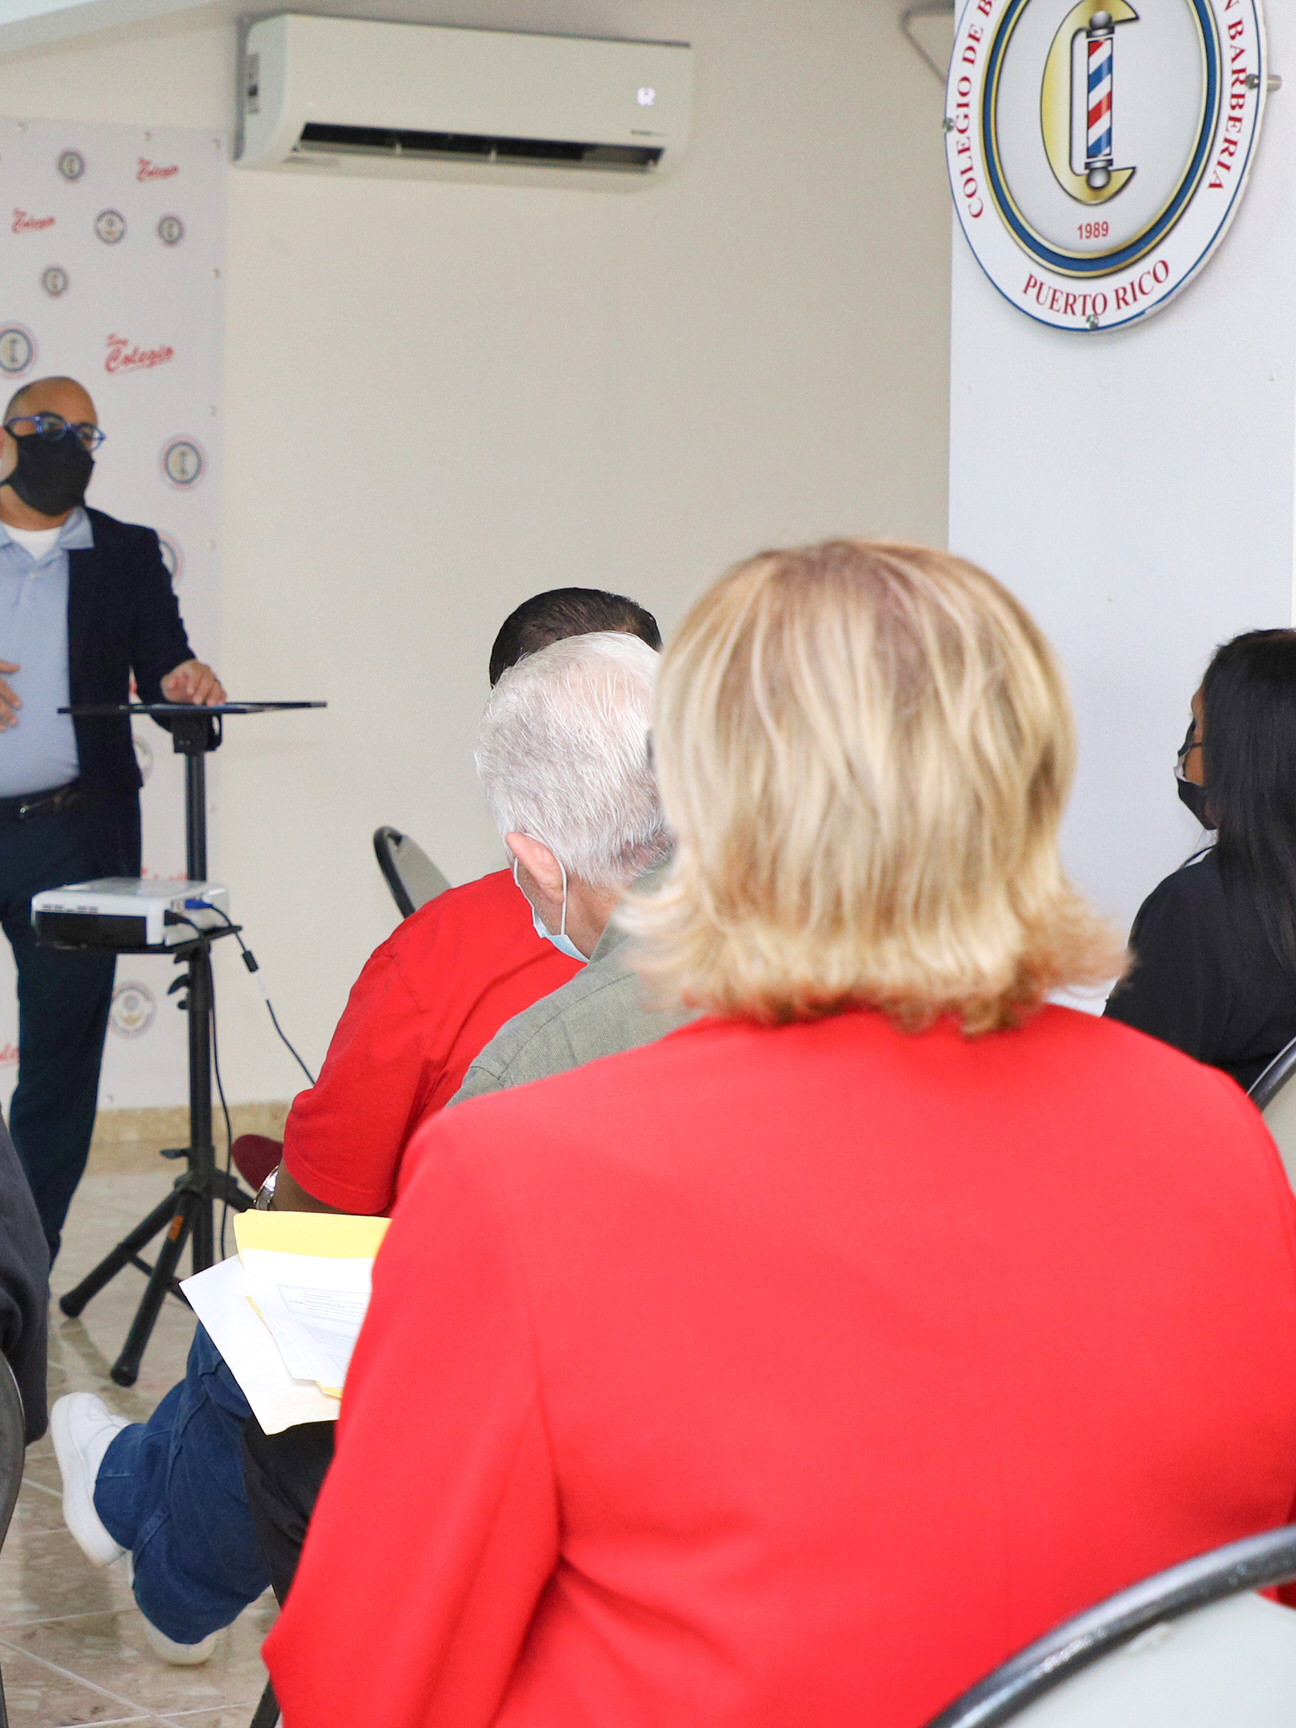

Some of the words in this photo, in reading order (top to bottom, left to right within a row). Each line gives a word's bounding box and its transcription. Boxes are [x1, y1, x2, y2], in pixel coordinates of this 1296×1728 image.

[961, 23, 985, 66] DE
[1207, 18, 1249, 191] BARBERIA
[955, 76, 985, 219] COLEGIO
[1077, 221, 1109, 241] 1989
[1021, 272, 1108, 318] PUERTO
[1114, 258, 1171, 312] RICO
